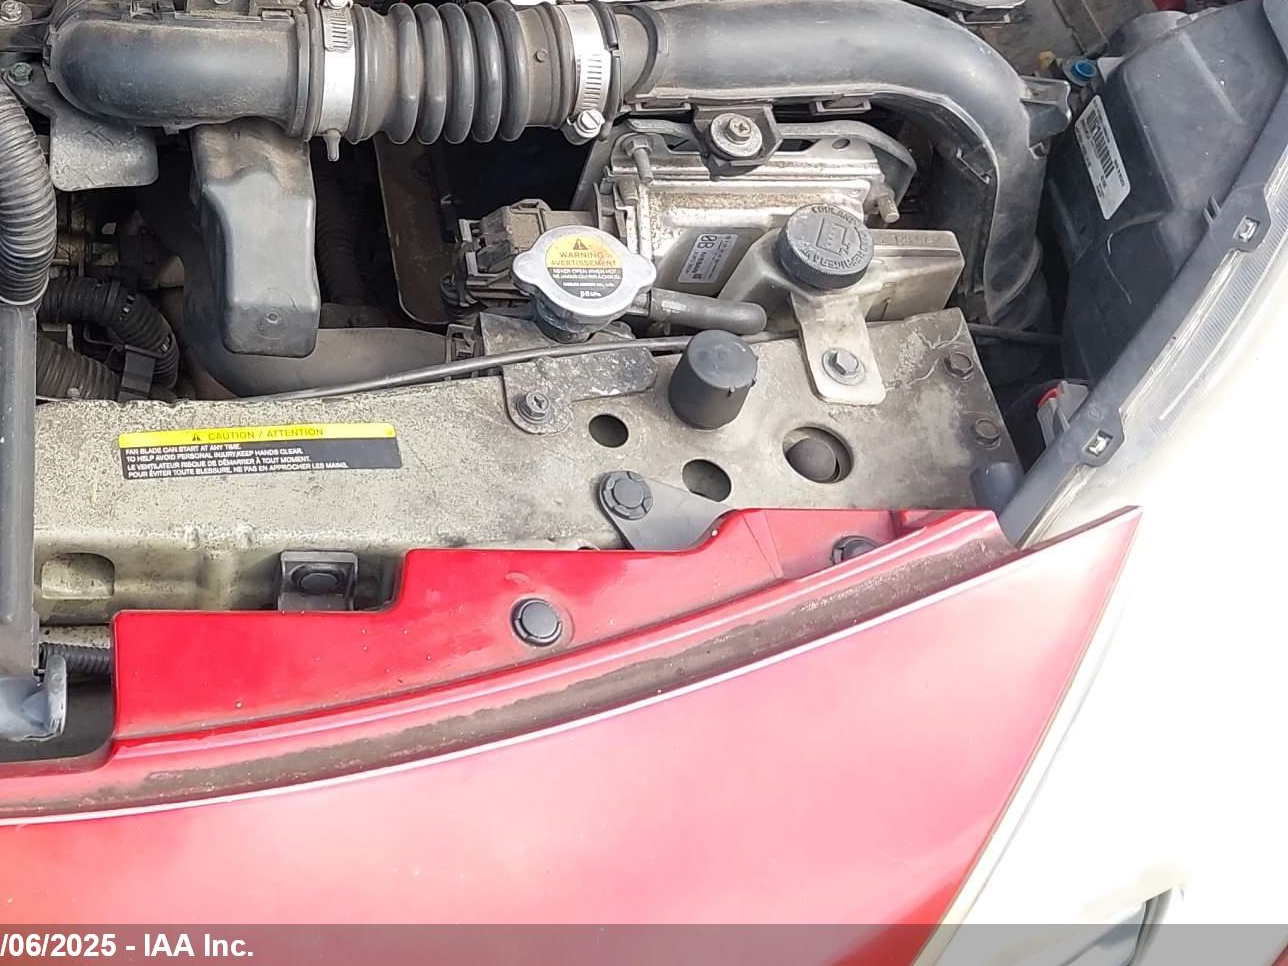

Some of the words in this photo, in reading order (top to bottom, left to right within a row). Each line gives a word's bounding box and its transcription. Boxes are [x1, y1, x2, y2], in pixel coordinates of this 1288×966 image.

[560, 251, 605, 259] WARNING
[208, 431, 255, 441] CAUTION
[267, 428, 323, 438] ATTENTION
[126, 455, 136, 463] TO
[137, 454, 154, 462] HELP
[155, 453, 176, 461] AVOID
[177, 451, 213, 460] PERSONAL
[255, 448, 279, 456] HANDS
[140, 447, 162, 455] BLADE
[163, 446, 178, 454] CAN
[209, 444, 223, 452] ANY
[224, 443, 242, 451] TIME.
[137, 462, 180, 471] VENTILATEUR
[181, 460, 207, 468] RISQUE
[218, 458, 255, 467] DÉMARRER
[150, 468, 172, 477] ÉVITER
[173, 468, 194, 476] TOUTE
[234, 465, 243, 473] NE
[269, 463, 311, 472] APPROCHER
